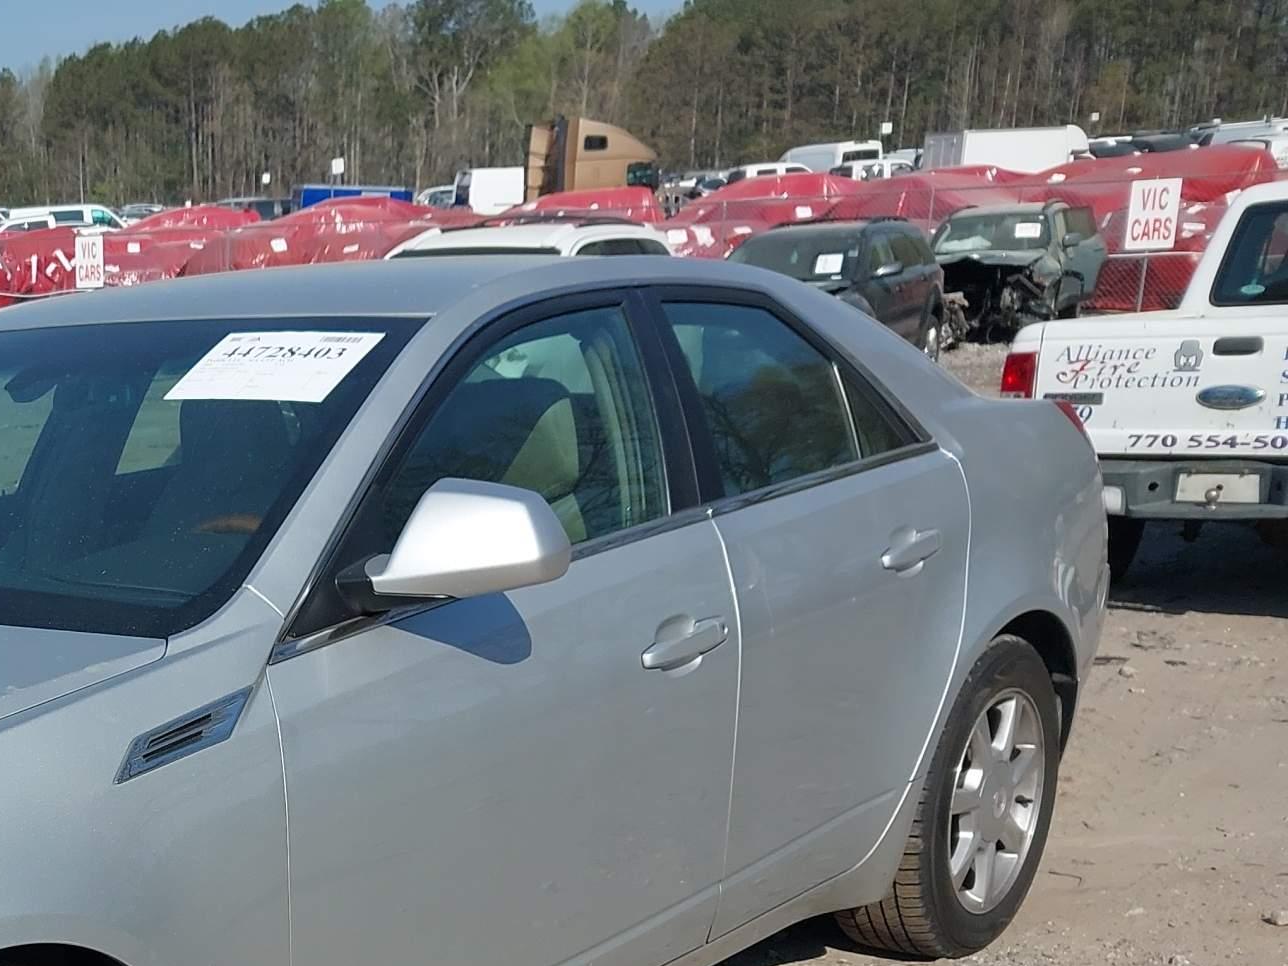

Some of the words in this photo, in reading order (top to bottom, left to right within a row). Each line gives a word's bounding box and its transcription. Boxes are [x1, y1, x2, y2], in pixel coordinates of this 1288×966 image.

[1142, 187, 1170, 211] VIC
[1131, 217, 1173, 241] CARS
[81, 241, 97, 260] VIC
[78, 263, 102, 282] CARS
[223, 345, 348, 360] 44728403
[1055, 344, 1157, 364] Alliance
[1055, 359, 1141, 385] Fire
[1072, 370, 1201, 390] Protection
[1127, 433, 1178, 449] 770
[1187, 434, 1288, 450] 554-50
